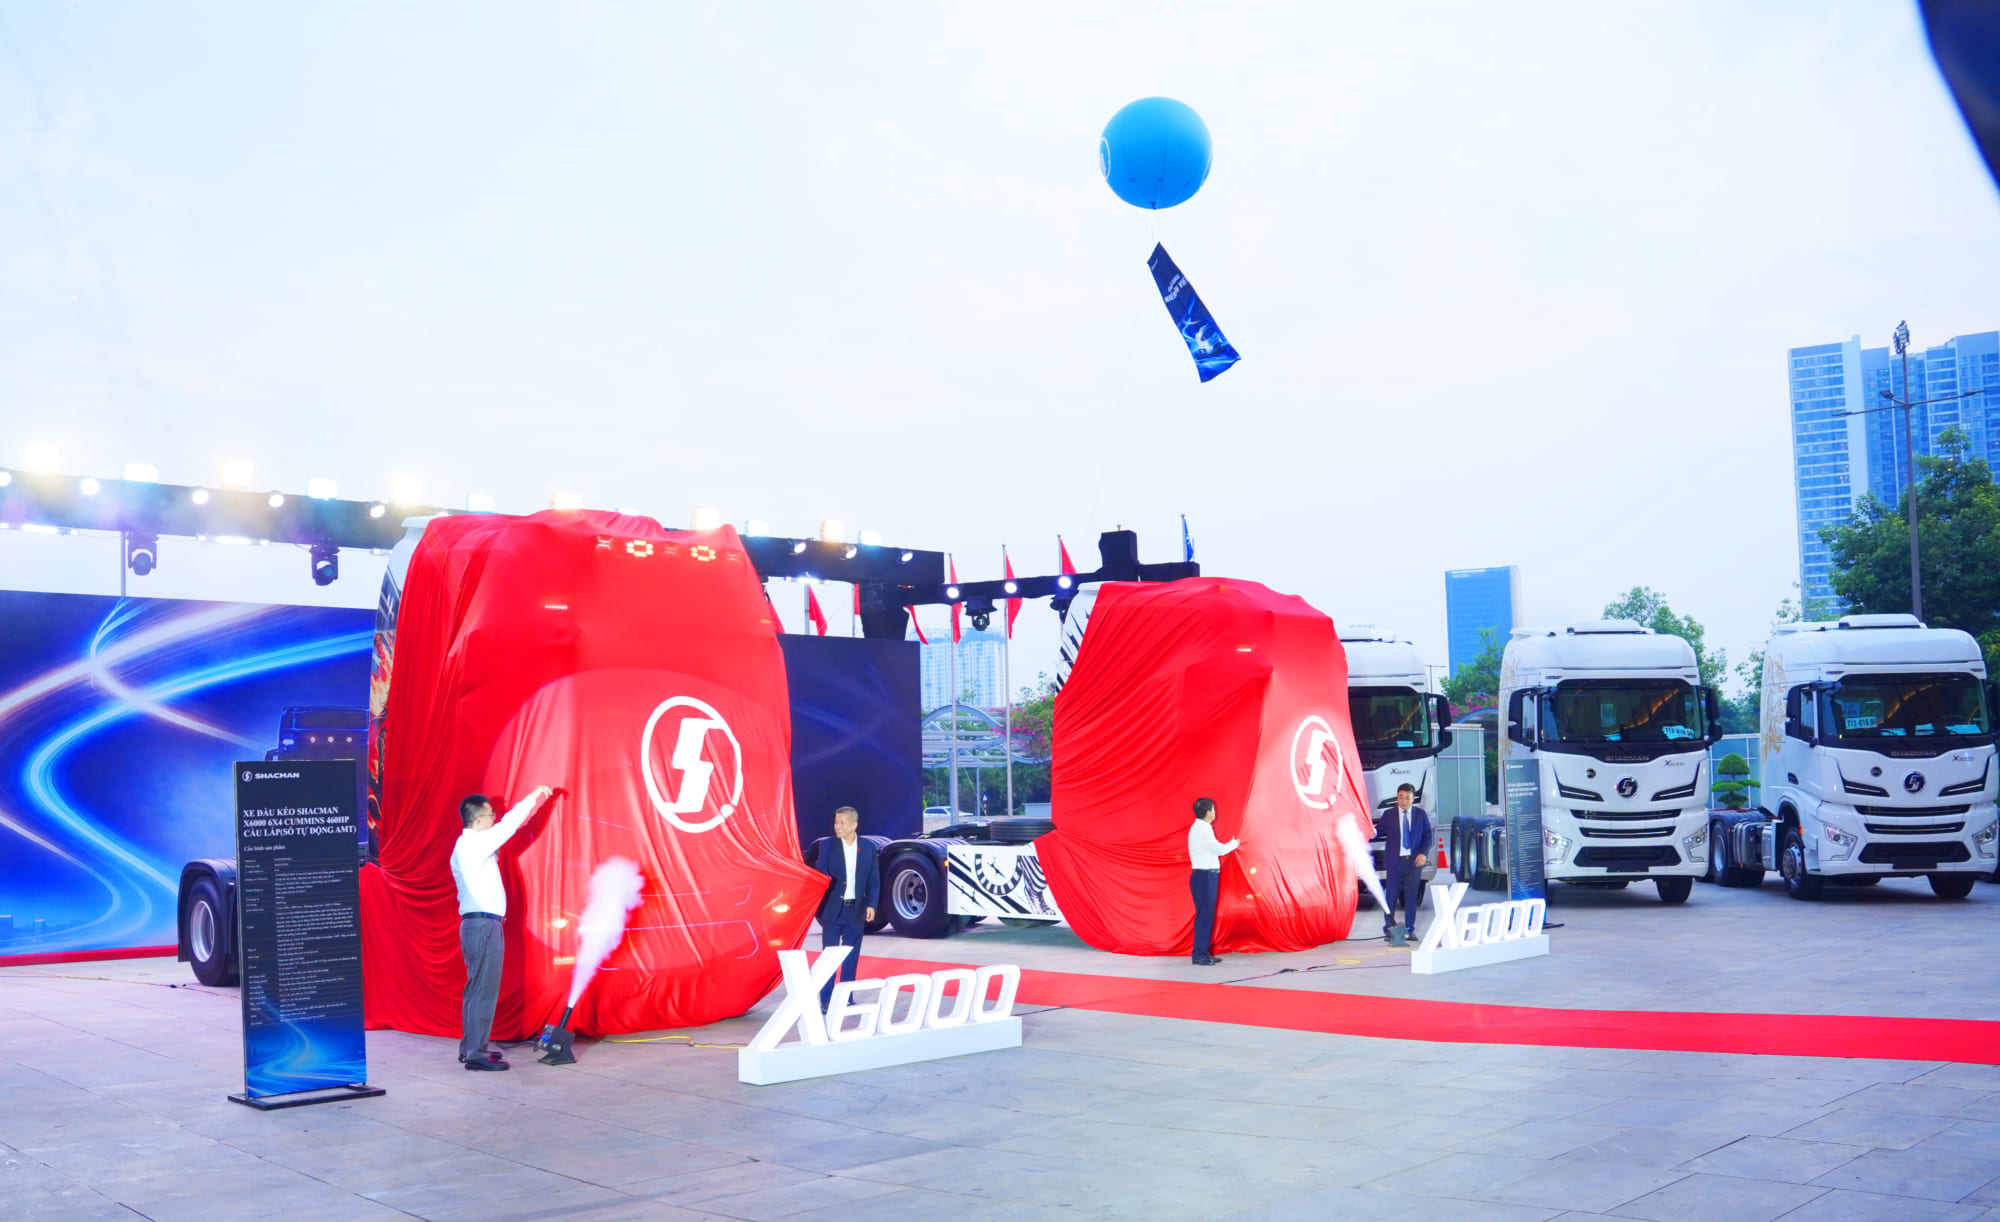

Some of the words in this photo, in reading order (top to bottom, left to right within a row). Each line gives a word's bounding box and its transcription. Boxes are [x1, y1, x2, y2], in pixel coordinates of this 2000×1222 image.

[243, 809, 256, 818] XE
[296, 807, 339, 816] SHACMAN
[243, 819, 267, 828] X6000
[268, 818, 283, 827] 6X4
[284, 817, 325, 826] CUMMINS
[326, 815, 350, 824] 460HP
[1418, 882, 1547, 952] X6000
[746, 945, 1021, 1051] X6000
